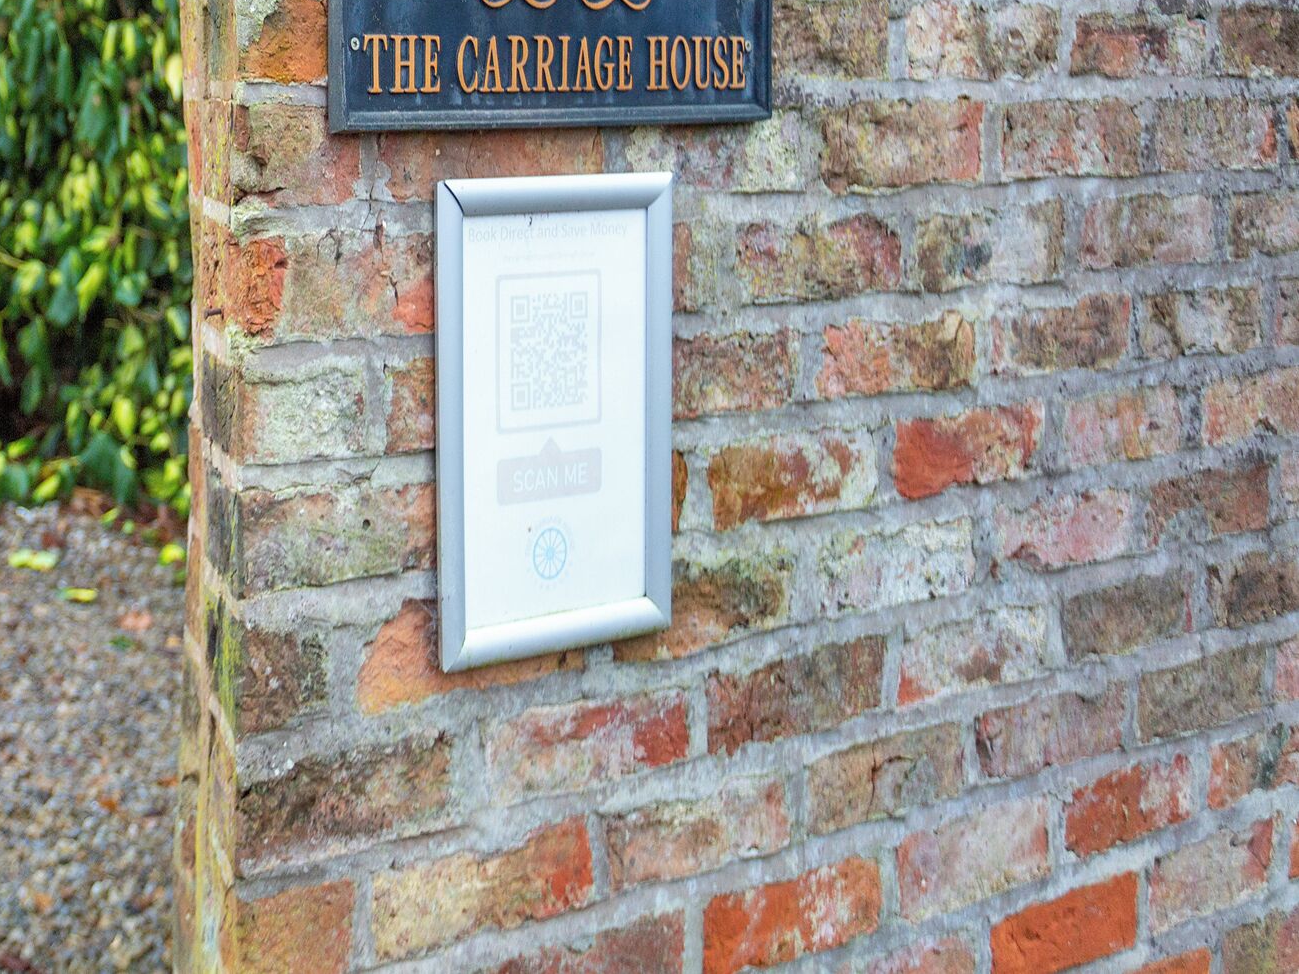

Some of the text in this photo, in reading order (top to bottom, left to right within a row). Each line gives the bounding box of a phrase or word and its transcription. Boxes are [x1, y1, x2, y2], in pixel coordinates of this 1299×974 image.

[362, 34, 747, 94] THE CARRIAGE HOUSE
[468, 221, 628, 243] Book Direct and Save Money
[513, 461, 588, 493] SCAN ME
